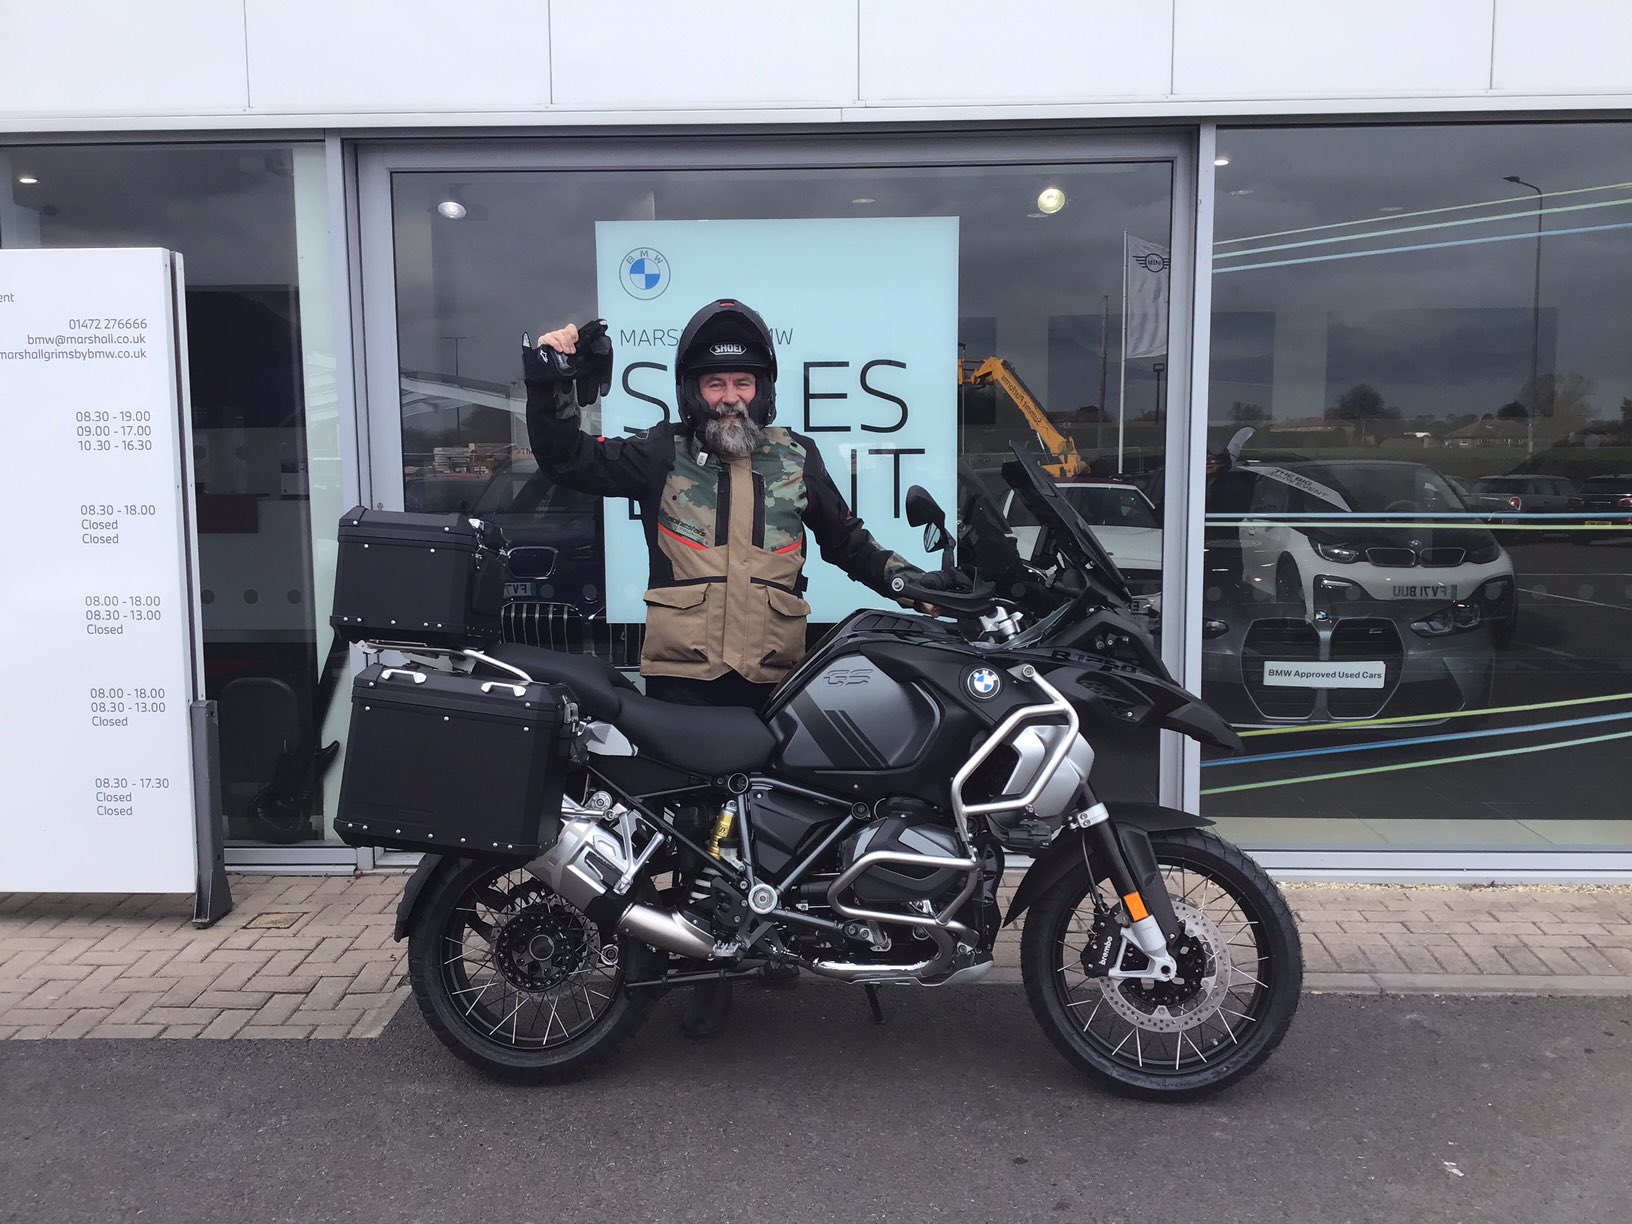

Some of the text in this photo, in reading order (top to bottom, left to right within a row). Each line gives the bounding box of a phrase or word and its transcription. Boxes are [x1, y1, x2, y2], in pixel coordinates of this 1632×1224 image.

[626, 250, 664, 265] BMW
[69, 318, 148, 330] 01472 276666
[27, 333, 146, 346] bmw@marshall.co.uk
[714, 343, 743, 353] SHOEI
[76, 411, 110, 422] 08.30
[120, 411, 151, 422] 19.00
[76, 425, 111, 437] 09.00
[121, 425, 152, 436] 17.00
[78, 440, 111, 451] 10.30
[122, 439, 152, 451] 16.30
[80, 504, 114, 516] 08.30
[124, 504, 156, 516] 18.00
[81, 518, 119, 530] Closed
[82, 533, 119, 545] Closed
[85, 595, 119, 607] 08.00
[129, 595, 161, 607] 18.00
[86, 609, 120, 621] 08.30
[130, 609, 162, 621] 13.00
[86, 623, 124, 635] Closed
[824, 669, 874, 688] GS
[1268, 669, 1382, 679] BMW Approved Used Cars
[90, 687, 124, 699] 08.00
[134, 687, 165, 699] 18.00
[91, 701, 125, 713] 08.30
[135, 701, 166, 713] 13.00
[91, 716, 128, 727] Closed
[95, 777, 128, 789] 08.30
[139, 777, 169, 789] 17.30
[96, 791, 132, 803] Closed
[97, 805, 133, 816] Closed
[1098, 936, 1113, 966] brembo
